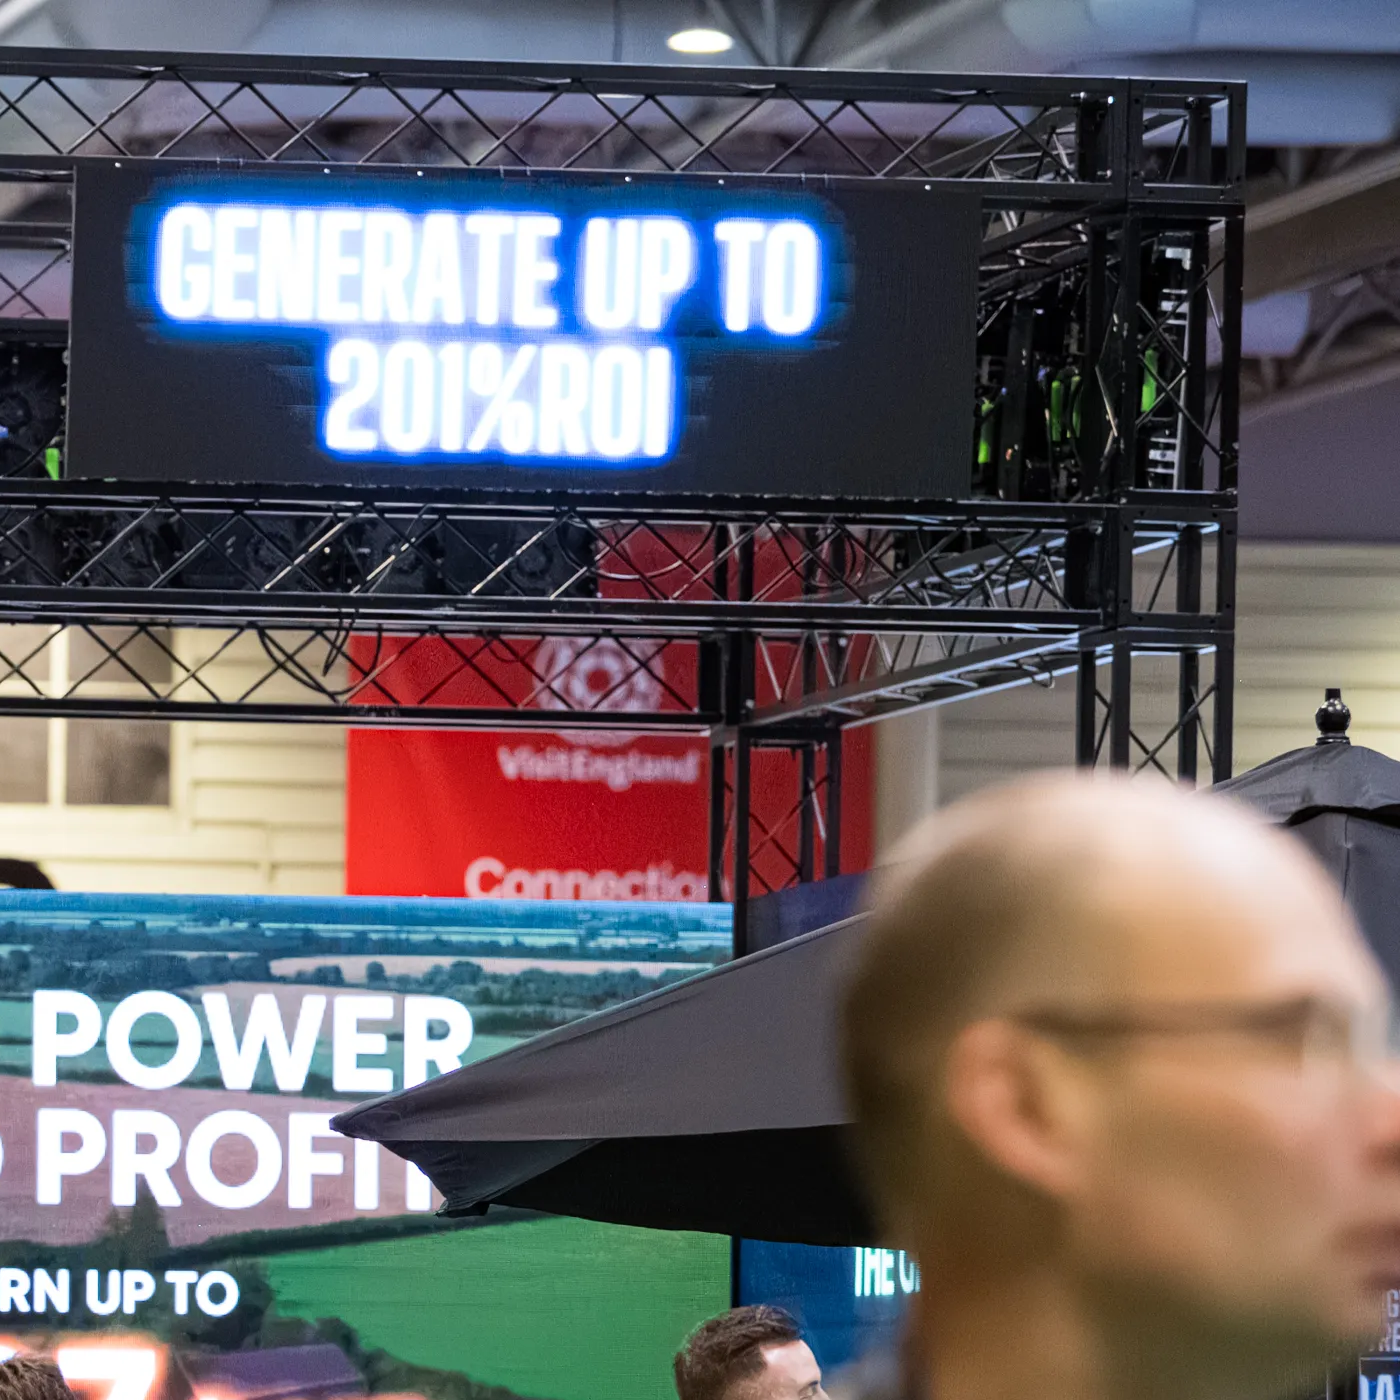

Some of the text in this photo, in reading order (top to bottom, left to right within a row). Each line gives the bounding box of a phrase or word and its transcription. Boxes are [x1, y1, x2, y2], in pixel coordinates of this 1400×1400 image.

[159, 203, 818, 336] GENERATE UP TO
[325, 338, 672, 458] 201%ROI
[498, 744, 699, 792] VisitEngland
[32, 988, 476, 1096] POWER
[85, 1269, 157, 1316] UP
[166, 1270, 240, 1318] TO
